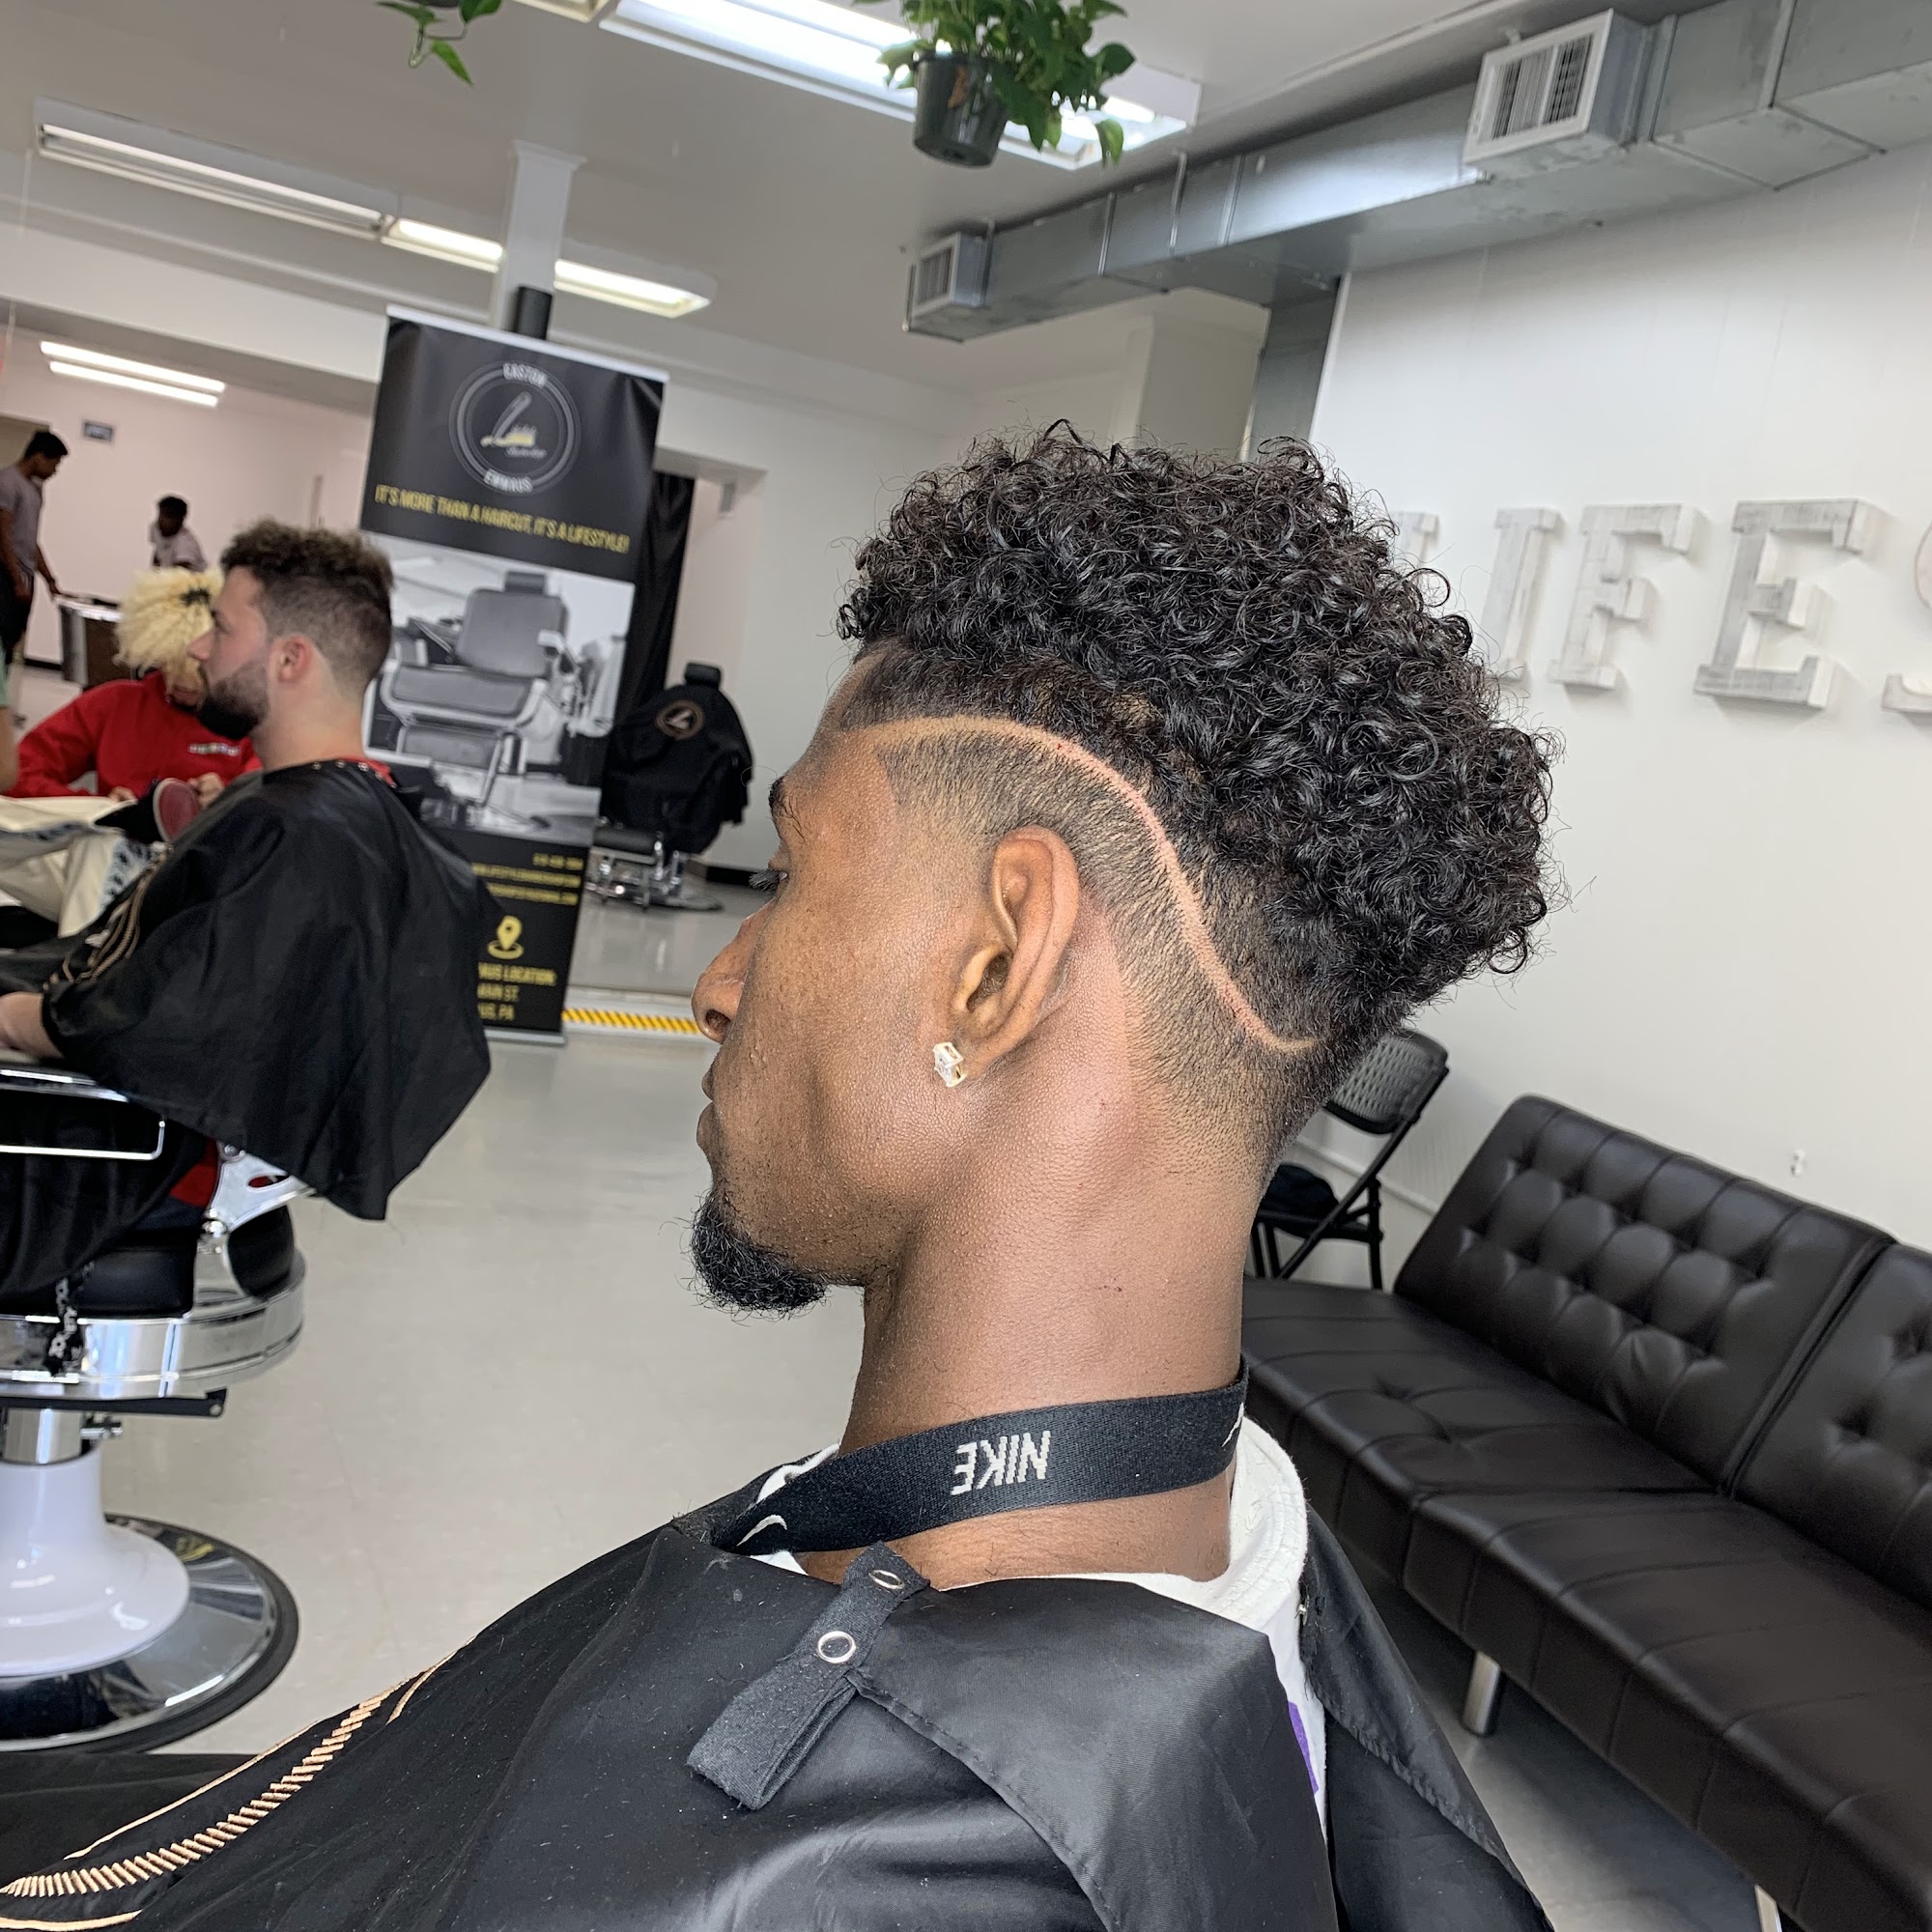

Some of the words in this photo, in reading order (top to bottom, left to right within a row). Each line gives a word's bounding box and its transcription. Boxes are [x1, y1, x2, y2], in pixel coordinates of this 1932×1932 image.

[375, 484, 400, 507] IT'S
[399, 489, 436, 515] MORE
[437, 496, 471, 522] THAN
[470, 503, 481, 523] A
[534, 517, 557, 540] IT'S
[557, 522, 568, 541] A
[1392, 497, 1932, 713] IFE
